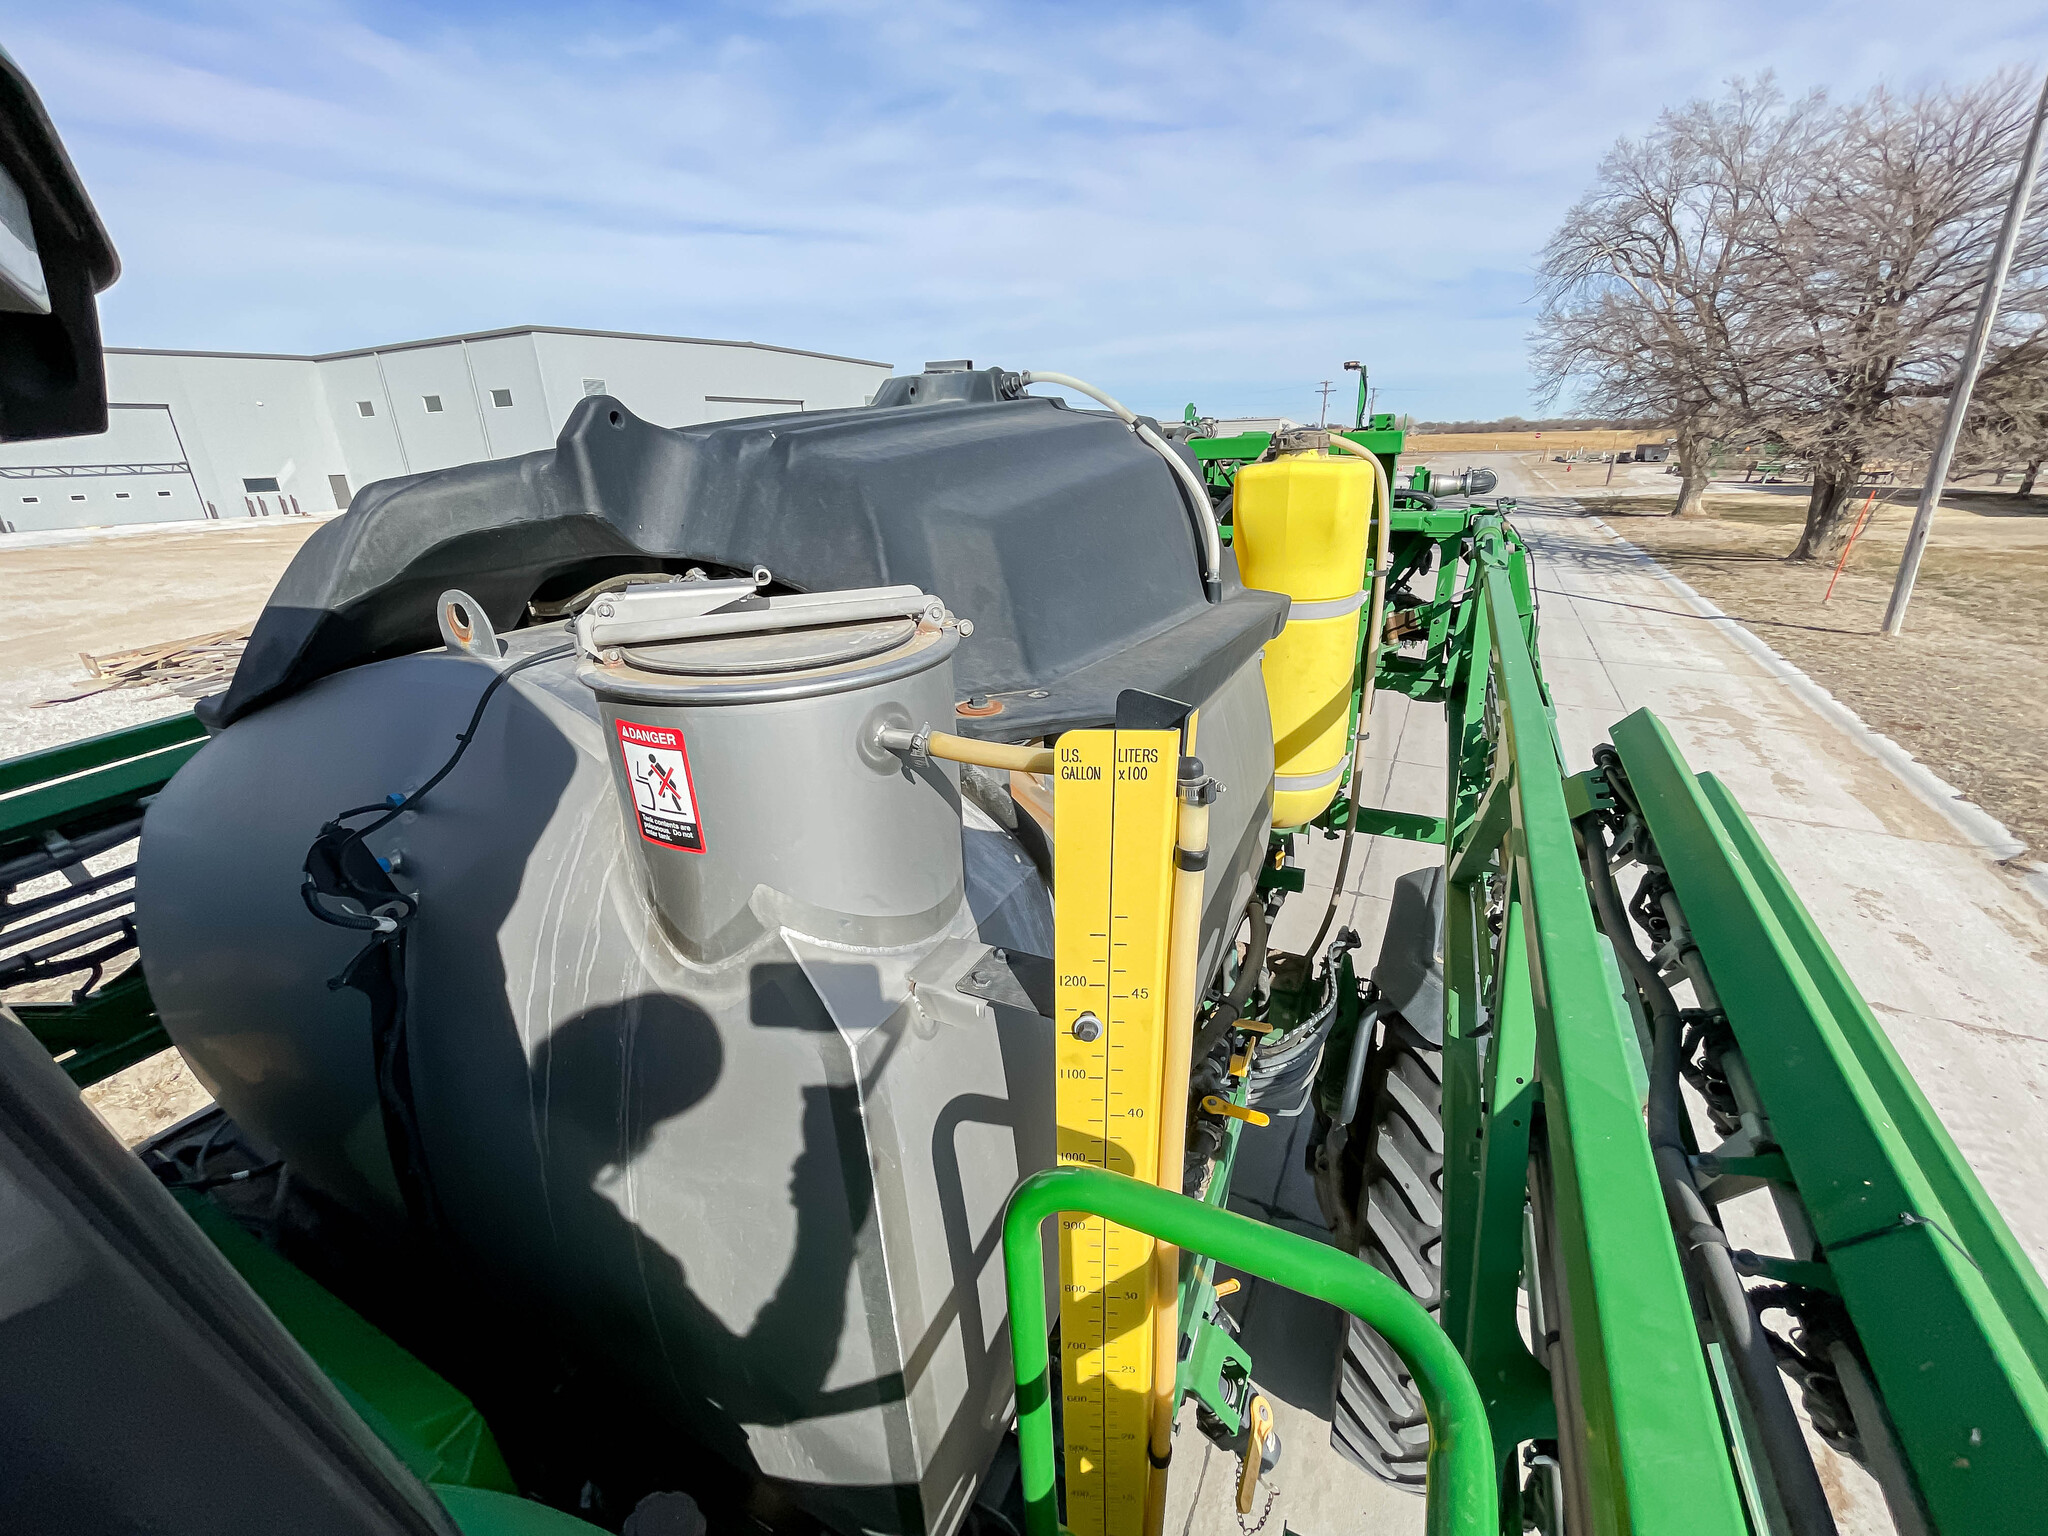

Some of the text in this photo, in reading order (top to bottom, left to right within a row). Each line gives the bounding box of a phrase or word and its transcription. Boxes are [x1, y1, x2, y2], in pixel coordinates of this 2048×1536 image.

[628, 727, 677, 746] DANGER
[1061, 748, 1082, 763] U.S.
[1118, 748, 1158, 763] LITERS
[1061, 766, 1101, 780] GALLON
[1118, 766, 1148, 780] x100
[642, 813, 655, 823] Tank
[655, 819, 680, 830] contents
[645, 829, 658, 837] enter
[673, 829, 682, 837] Do
[1060, 975, 1087, 987] 1200
[1131, 988, 1149, 999] 45
[1060, 1069, 1086, 1079] 1100
[1127, 1108, 1144, 1118] 40
[1061, 1152, 1086, 1162] 1000
[1063, 1221, 1086, 1230] 900
[1066, 1342, 1087, 1350] 700
[1121, 1365, 1136, 1374] 25
